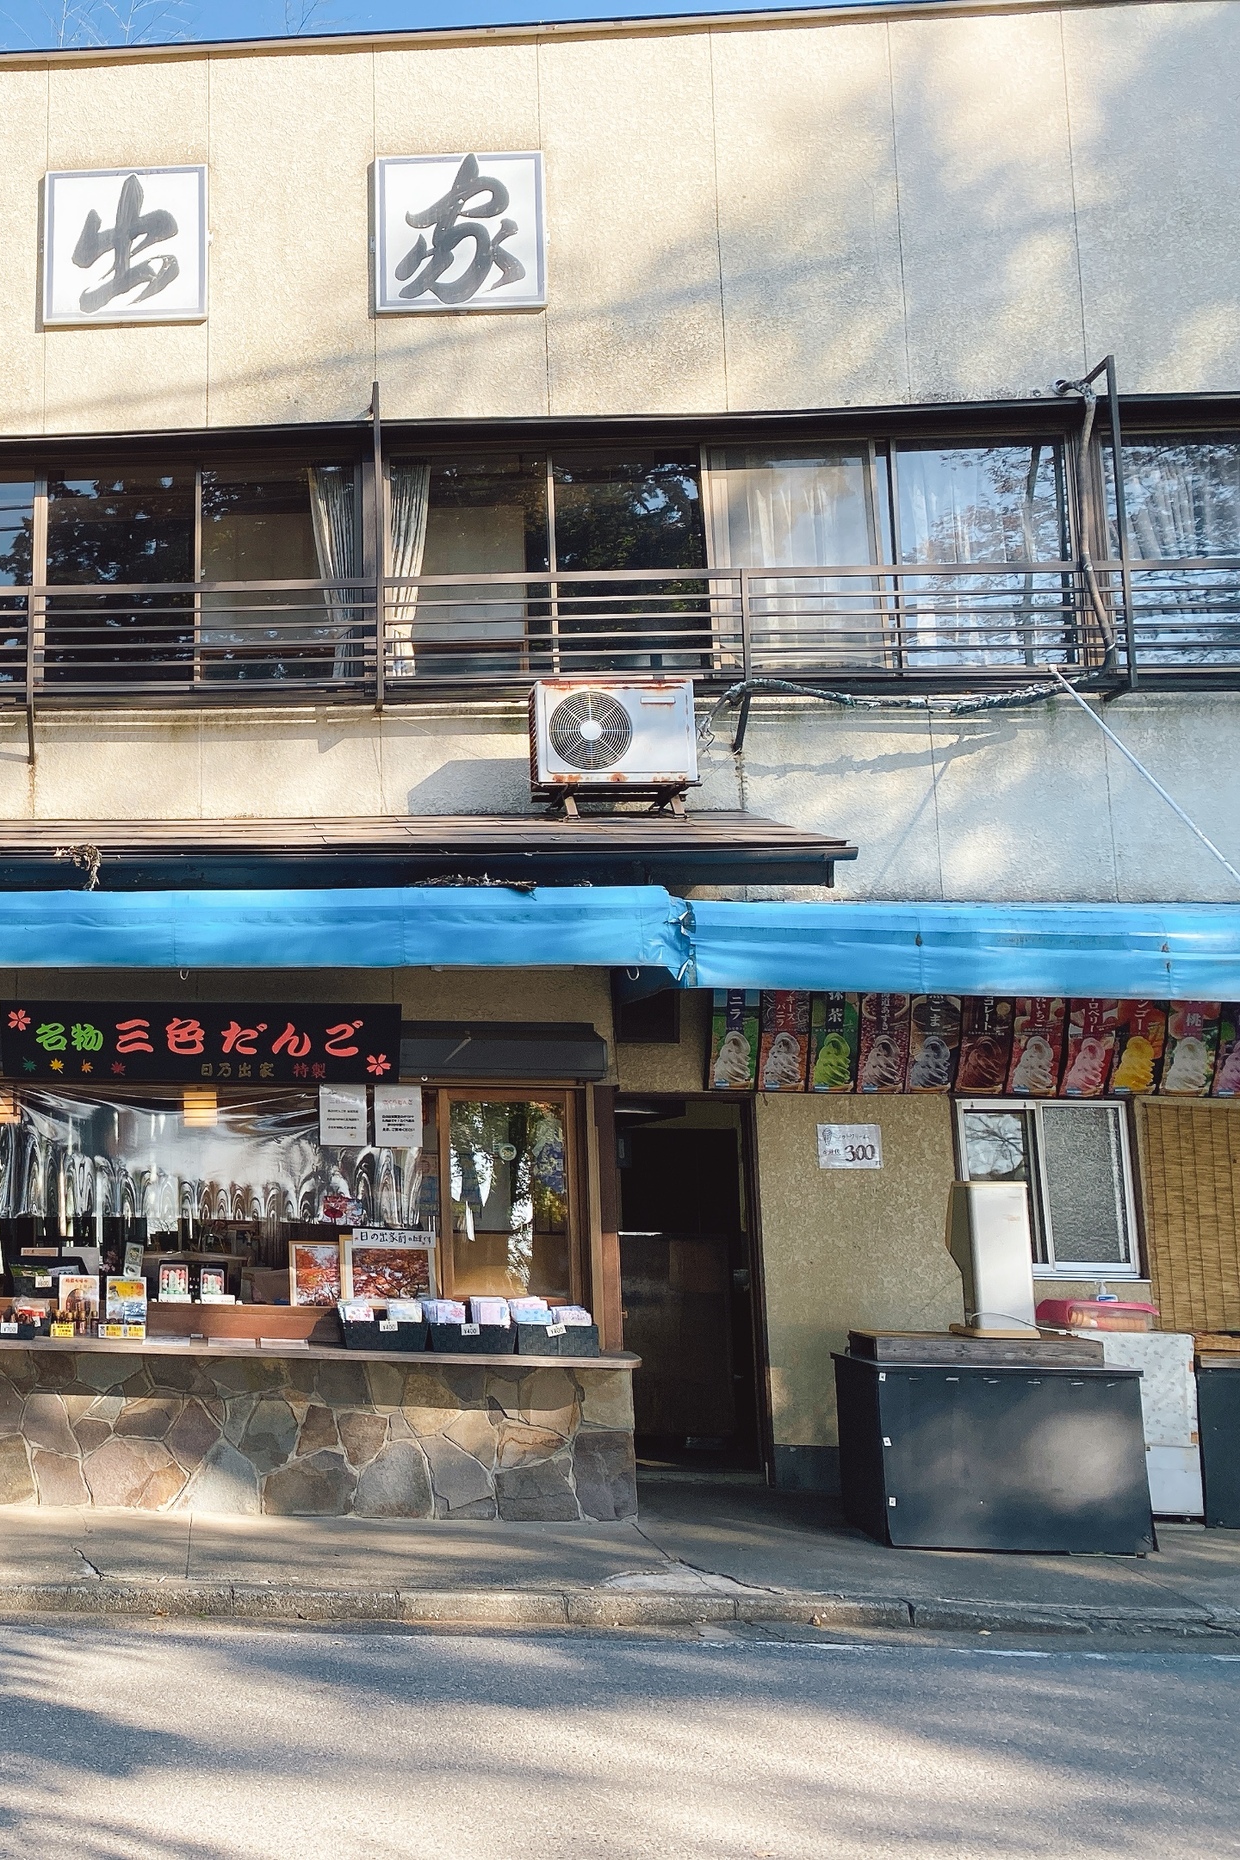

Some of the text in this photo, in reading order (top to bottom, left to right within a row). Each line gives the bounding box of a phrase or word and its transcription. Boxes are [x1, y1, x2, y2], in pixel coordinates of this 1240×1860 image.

[729, 989, 743, 1020] ニラ
[983, 997, 994, 1030] コレート
[35, 1017, 365, 1058] 名物 三色だんご
[293, 1062, 327, 1079] 特製
[844, 1144, 876, 1162] 300
